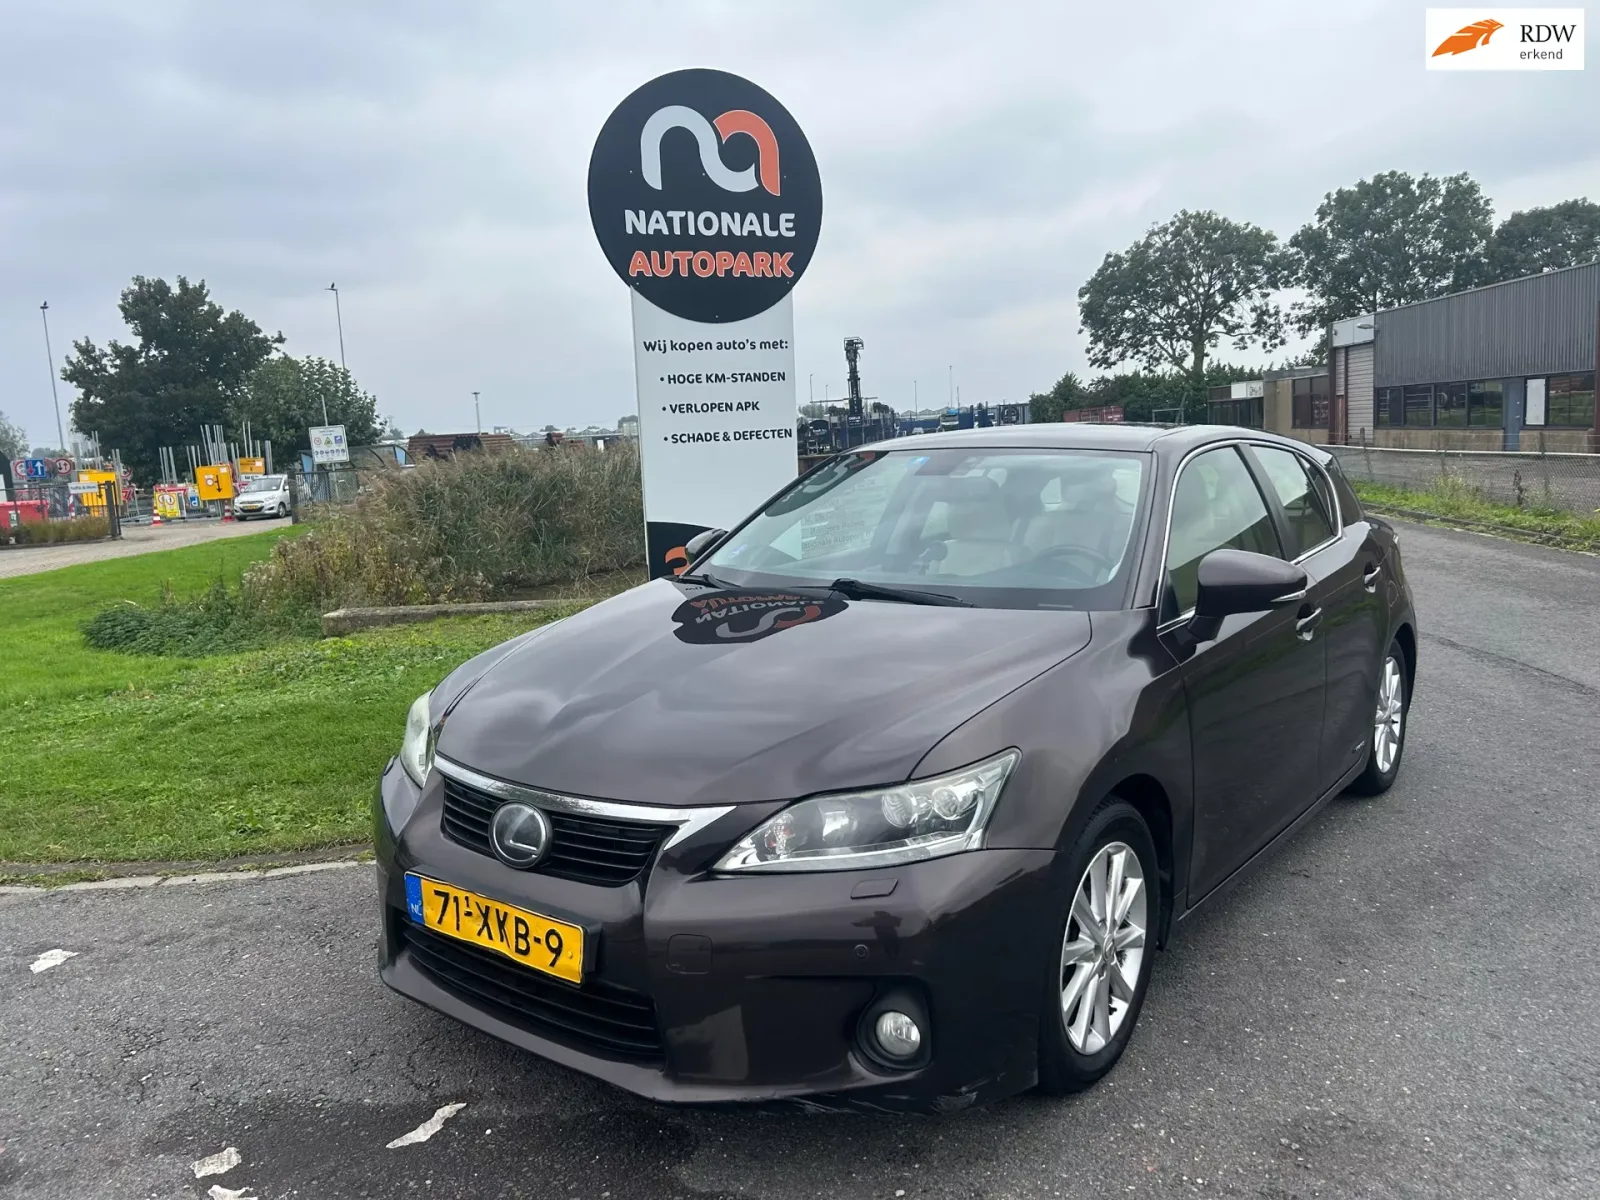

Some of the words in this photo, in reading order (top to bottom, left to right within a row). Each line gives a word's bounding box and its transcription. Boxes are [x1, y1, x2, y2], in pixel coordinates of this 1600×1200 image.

[624, 209, 796, 237] NATIONALE
[628, 250, 795, 278] AUTOPARK
[643, 339, 667, 354] Wij
[670, 340, 713, 353] kopen
[716, 338, 756, 350] auto's
[759, 339, 789, 350] met:
[667, 373, 703, 384] HOGE
[705, 371, 786, 384] KM-STANDEN
[669, 401, 733, 414] VERLOPEN
[735, 400, 761, 411] APK
[670, 431, 720, 444] SCHADE
[722, 431, 731, 442] &
[733, 428, 793, 441] DEFECTEN
[410, 903, 423, 917] NL
[433, 889, 564, 968] 71-XKB-9
